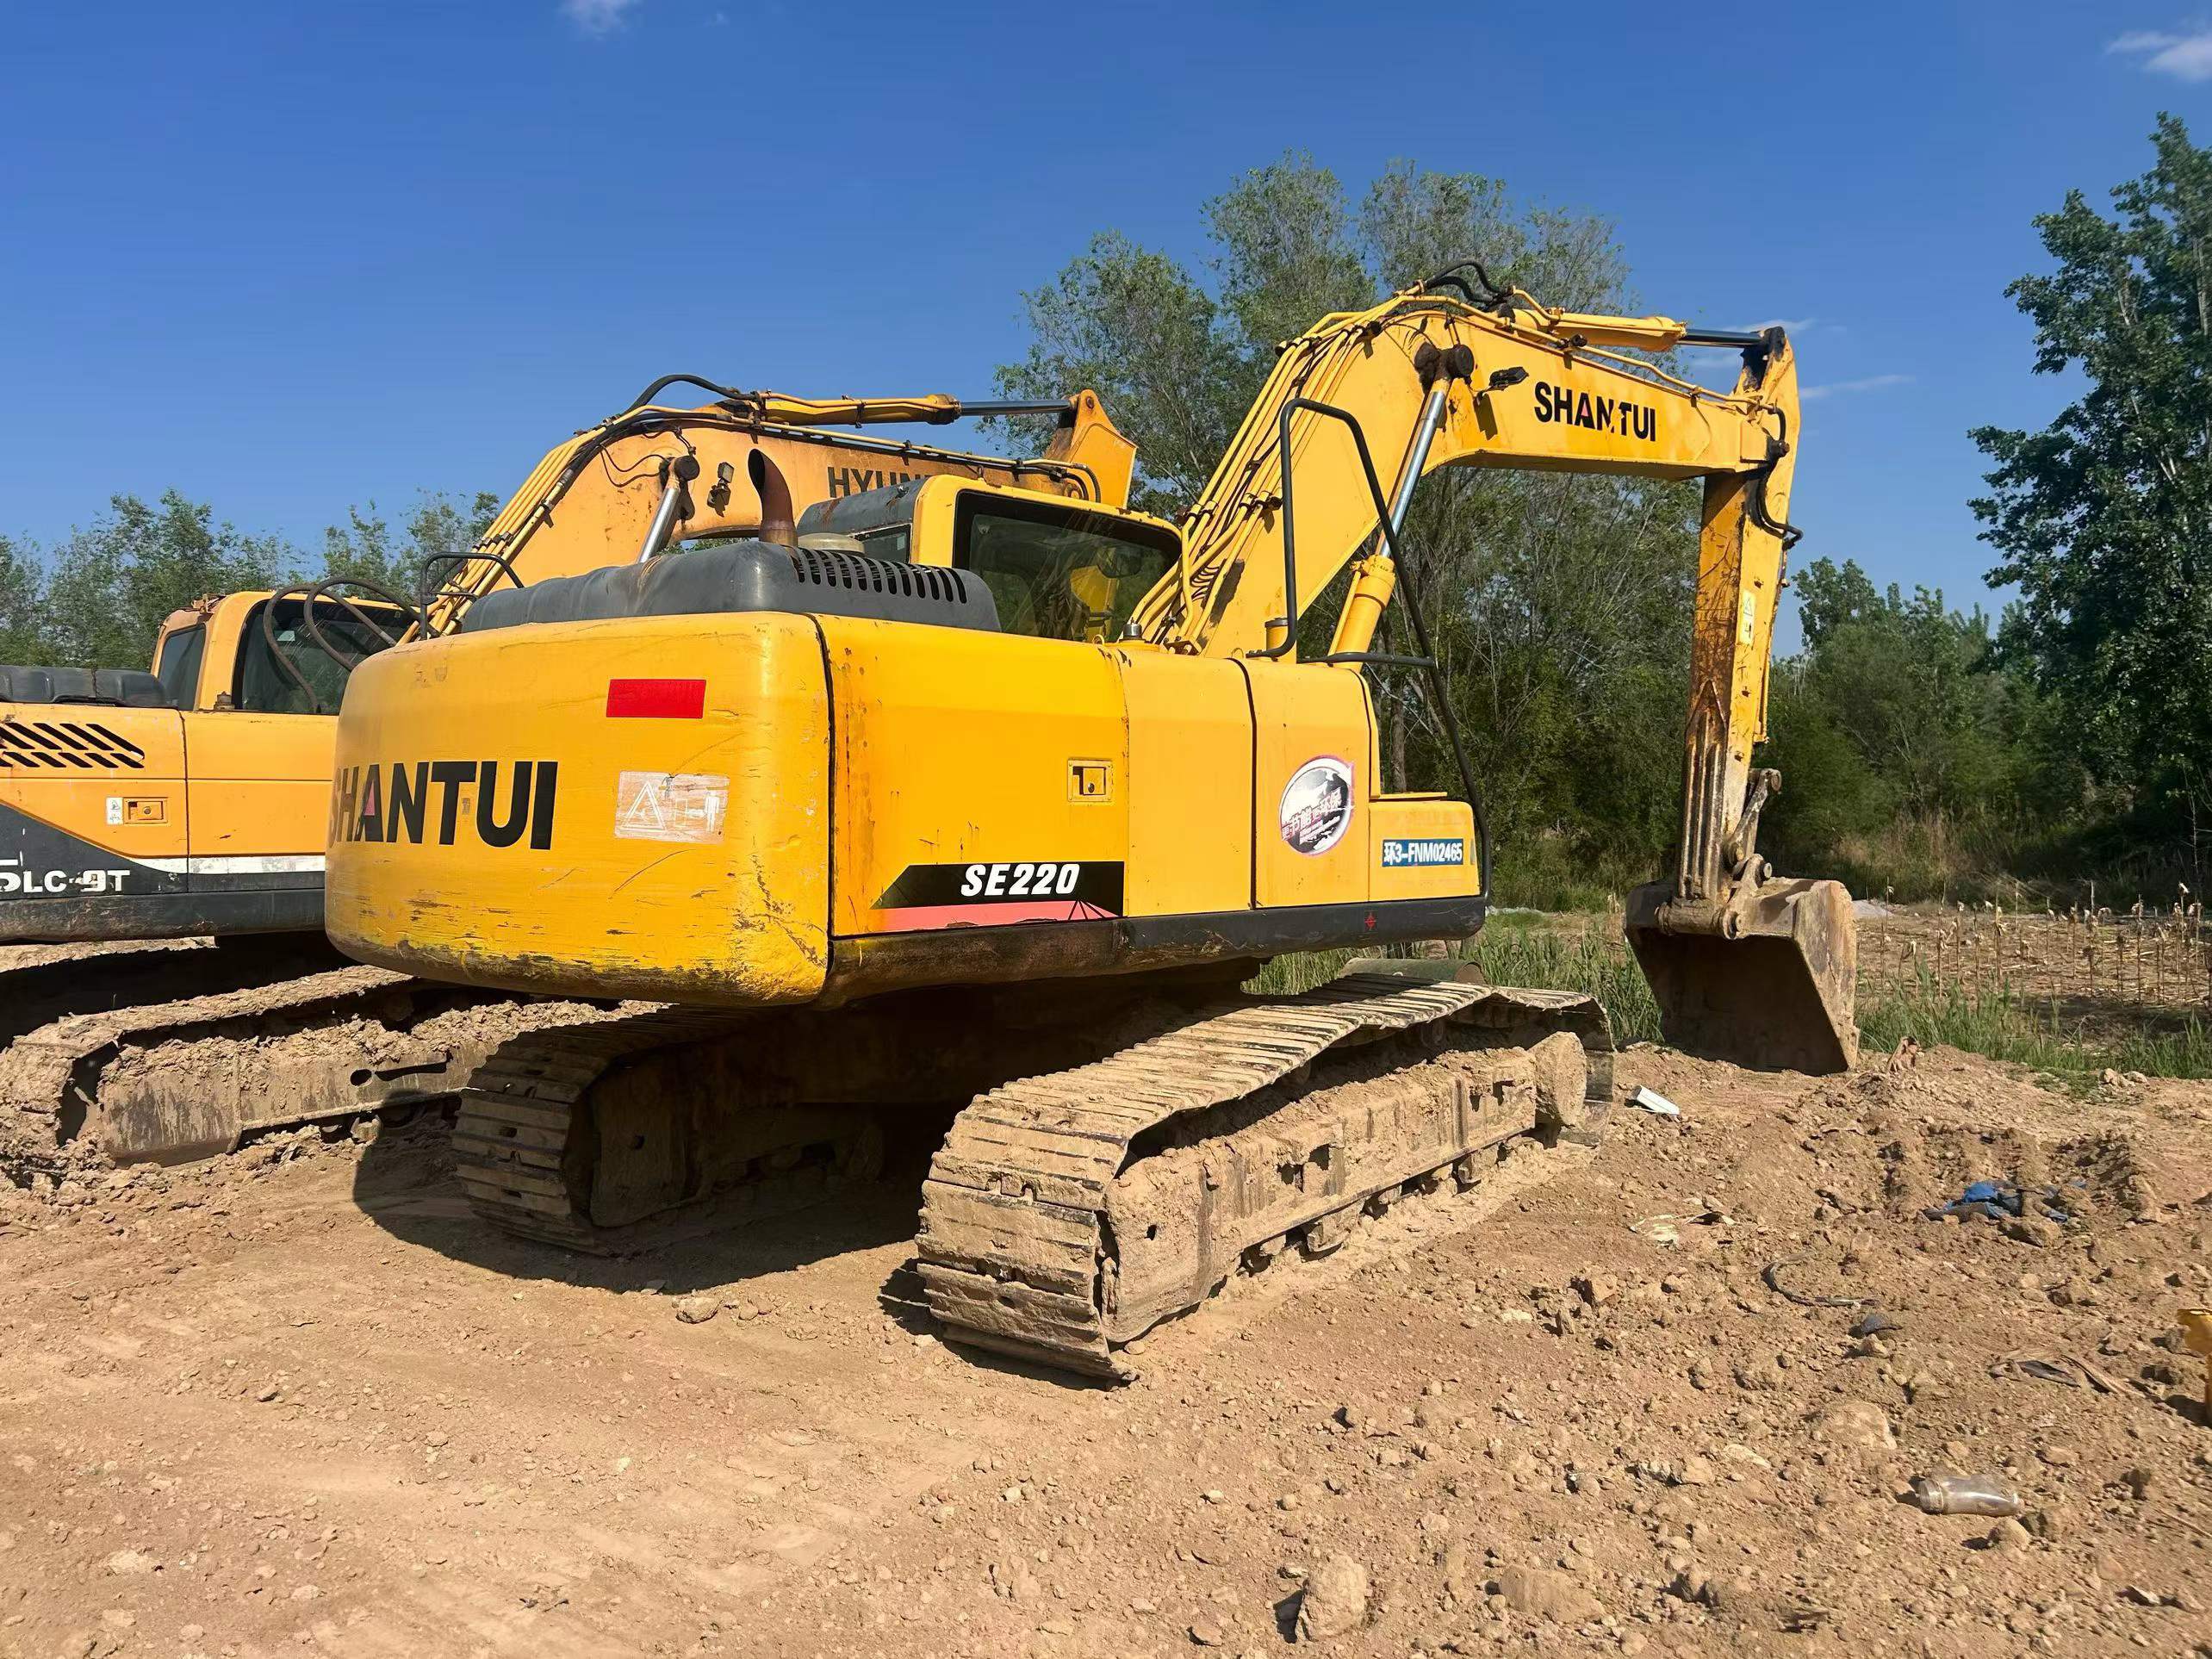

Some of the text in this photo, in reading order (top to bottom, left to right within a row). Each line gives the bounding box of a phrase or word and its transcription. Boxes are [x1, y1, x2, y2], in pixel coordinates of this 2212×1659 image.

[1534, 382, 1656, 442] SHANTUI
[328, 761, 559, 850] SHANTUI
[960, 863, 1080, 897] SE220
